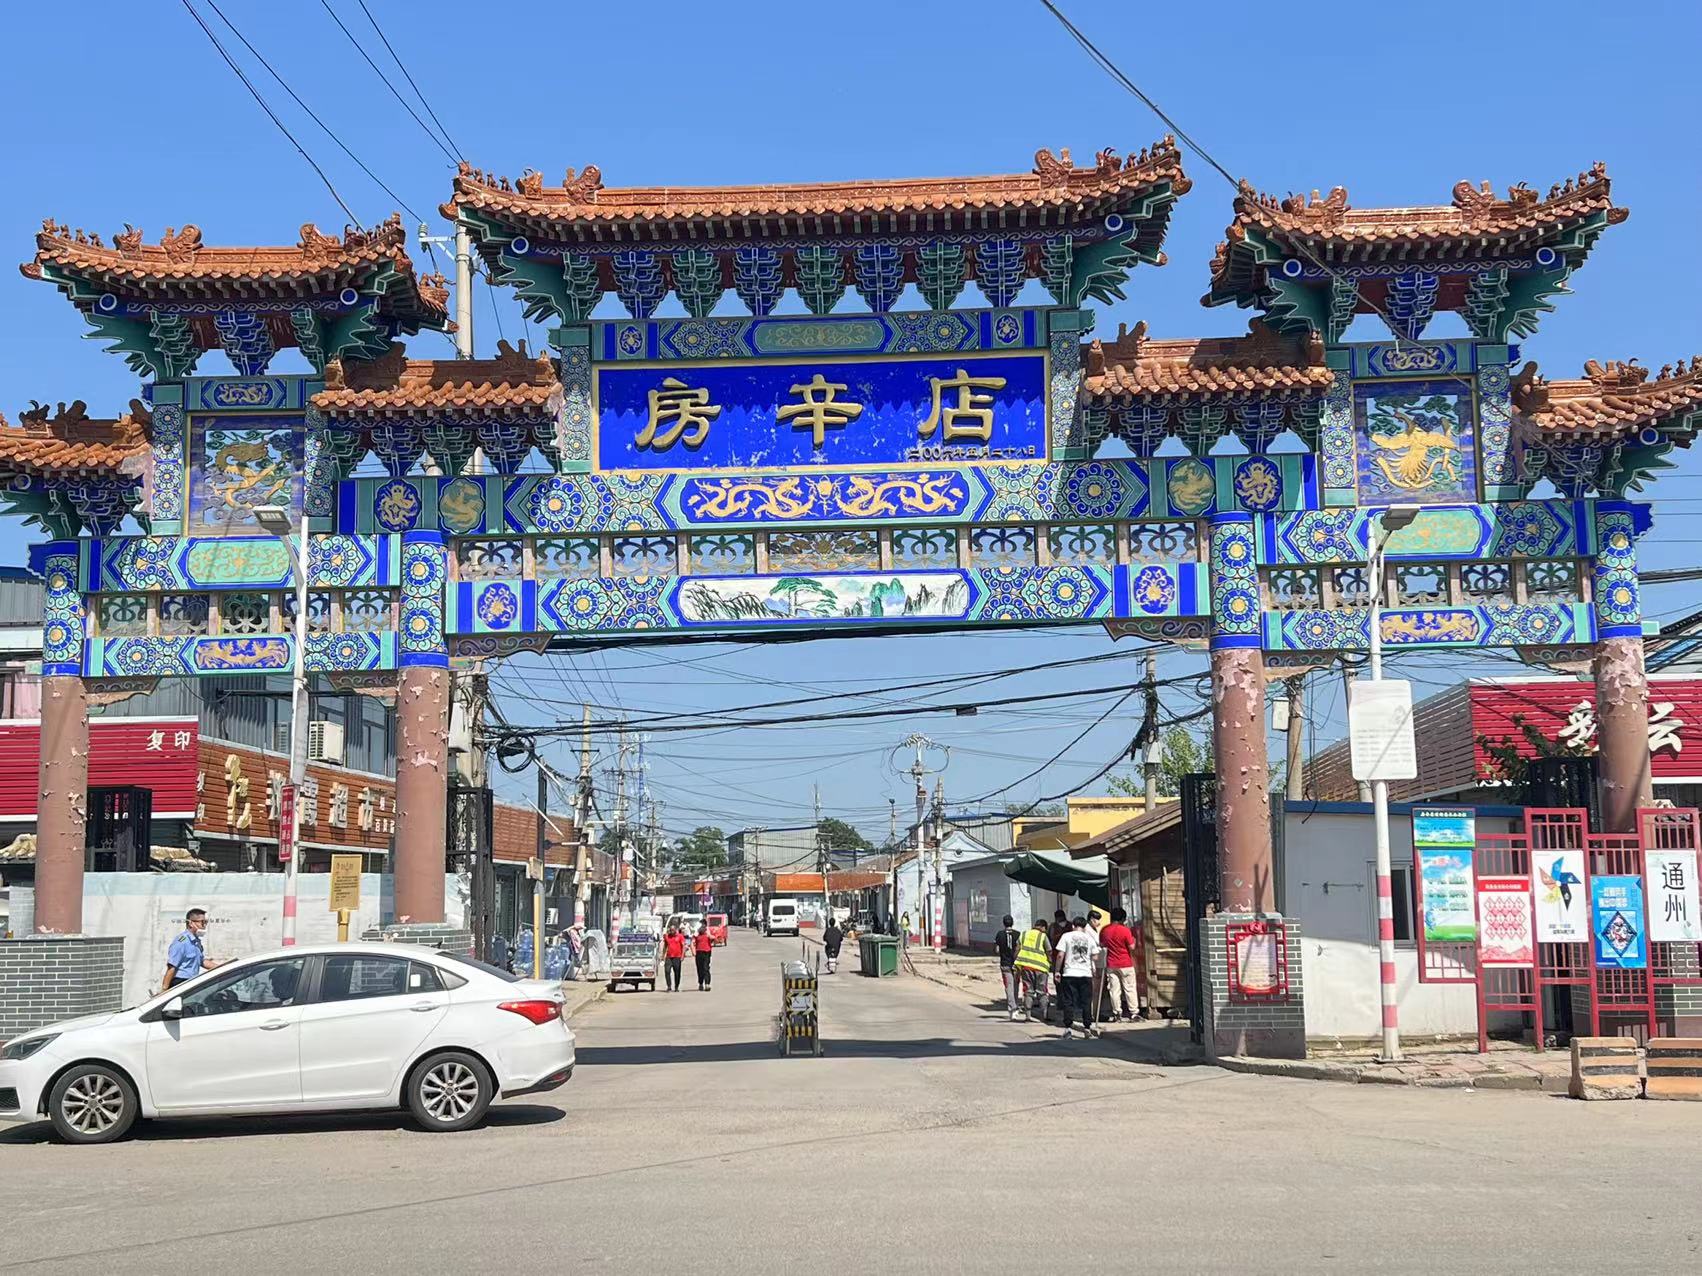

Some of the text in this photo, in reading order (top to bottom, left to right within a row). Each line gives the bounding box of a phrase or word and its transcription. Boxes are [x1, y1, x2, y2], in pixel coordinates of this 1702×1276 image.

[634, 368, 1007, 449] 房辛店
[145, 729, 191, 751] 复印
[1661, 862, 1687, 922] 通州
